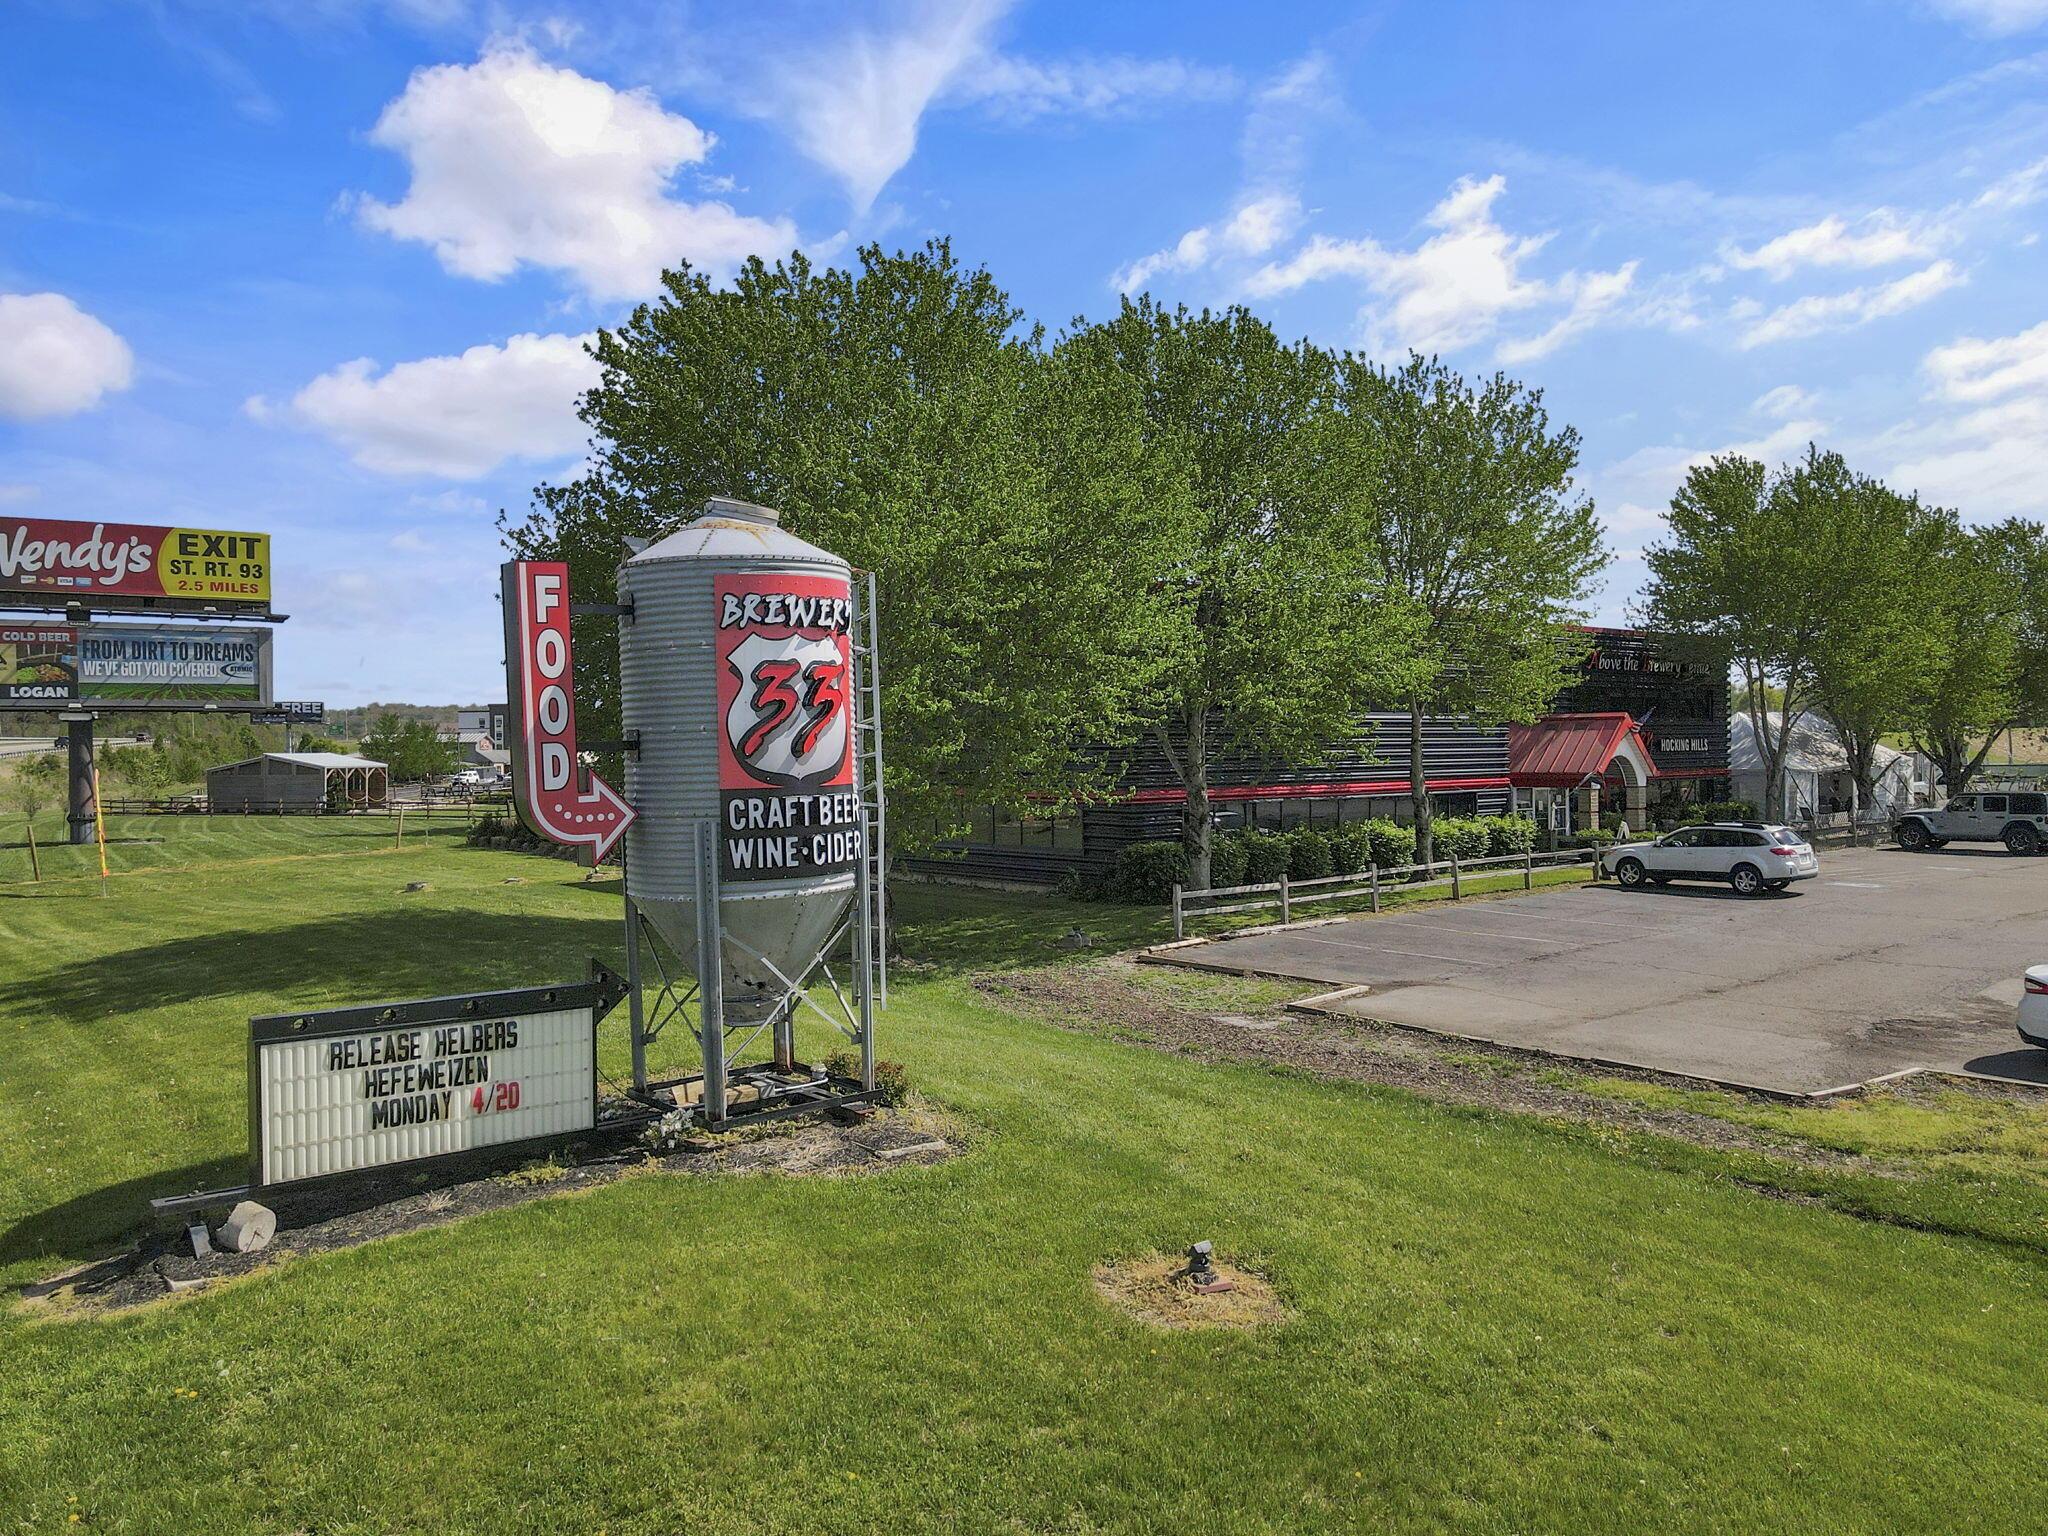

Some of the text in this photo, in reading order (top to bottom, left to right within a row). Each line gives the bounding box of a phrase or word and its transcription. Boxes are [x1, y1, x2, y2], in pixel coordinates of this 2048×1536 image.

[179, 533, 261, 559] EXIT
[170, 560, 263, 579] ST. RT. 93
[178, 581, 259, 594] 2.5 MILES
[720, 593, 853, 636] BREWERY
[2, 631, 70, 642] COLD BEER
[82, 640, 254, 662] FROM DIRT TO DREAMS
[1623, 655, 1639, 671] the
[83, 660, 220, 678] WE'VE GOT YOU COVERED.
[10, 686, 69, 698] LOGAN
[534, 574, 570, 792] FOOD
[281, 702, 322, 713] FREE
[742, 659, 845, 759] 33
[1660, 738, 1690, 751] HOCKING
[1691, 738, 1709, 751] HILLS
[729, 793, 860, 831] CRAFT BEER
[729, 830, 862, 869] WINE CIDER
[330, 1021, 518, 1071] RELEASE HELBERS
[365, 1056, 489, 1098] HEFEWEIZEN
[371, 1081, 520, 1130] MONDAY 4/20
